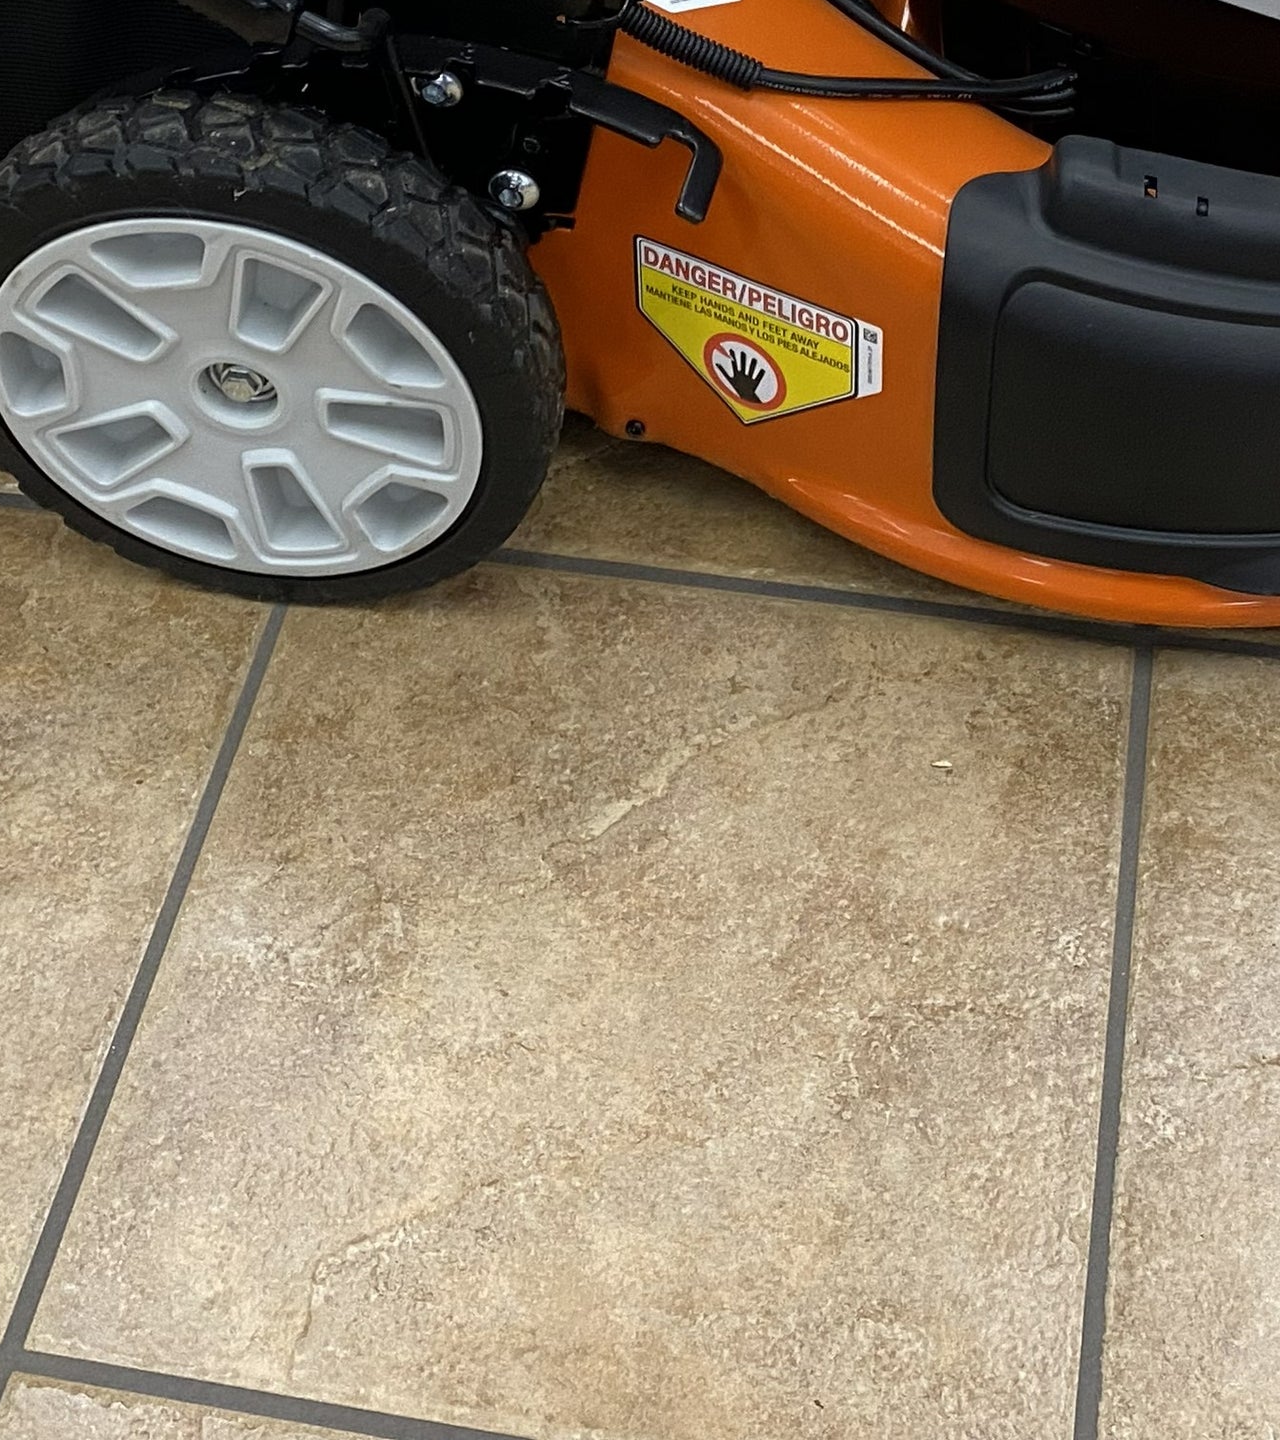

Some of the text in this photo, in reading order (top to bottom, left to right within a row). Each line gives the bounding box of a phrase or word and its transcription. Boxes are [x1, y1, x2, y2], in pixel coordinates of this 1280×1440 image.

[643, 245, 850, 344] DANGER/PELIGRO
[645, 285, 693, 312] MANTIENE
[694, 304, 713, 320] LAS
[713, 311, 749, 333] MANOS
[749, 325, 756, 335] Y
[756, 330, 775, 346] LOS
[777, 337, 798, 354] PIES
[799, 346, 850, 374] ALEJADOS
[671, 283, 819, 350] KEEP HANDS AND FEET AWAY
